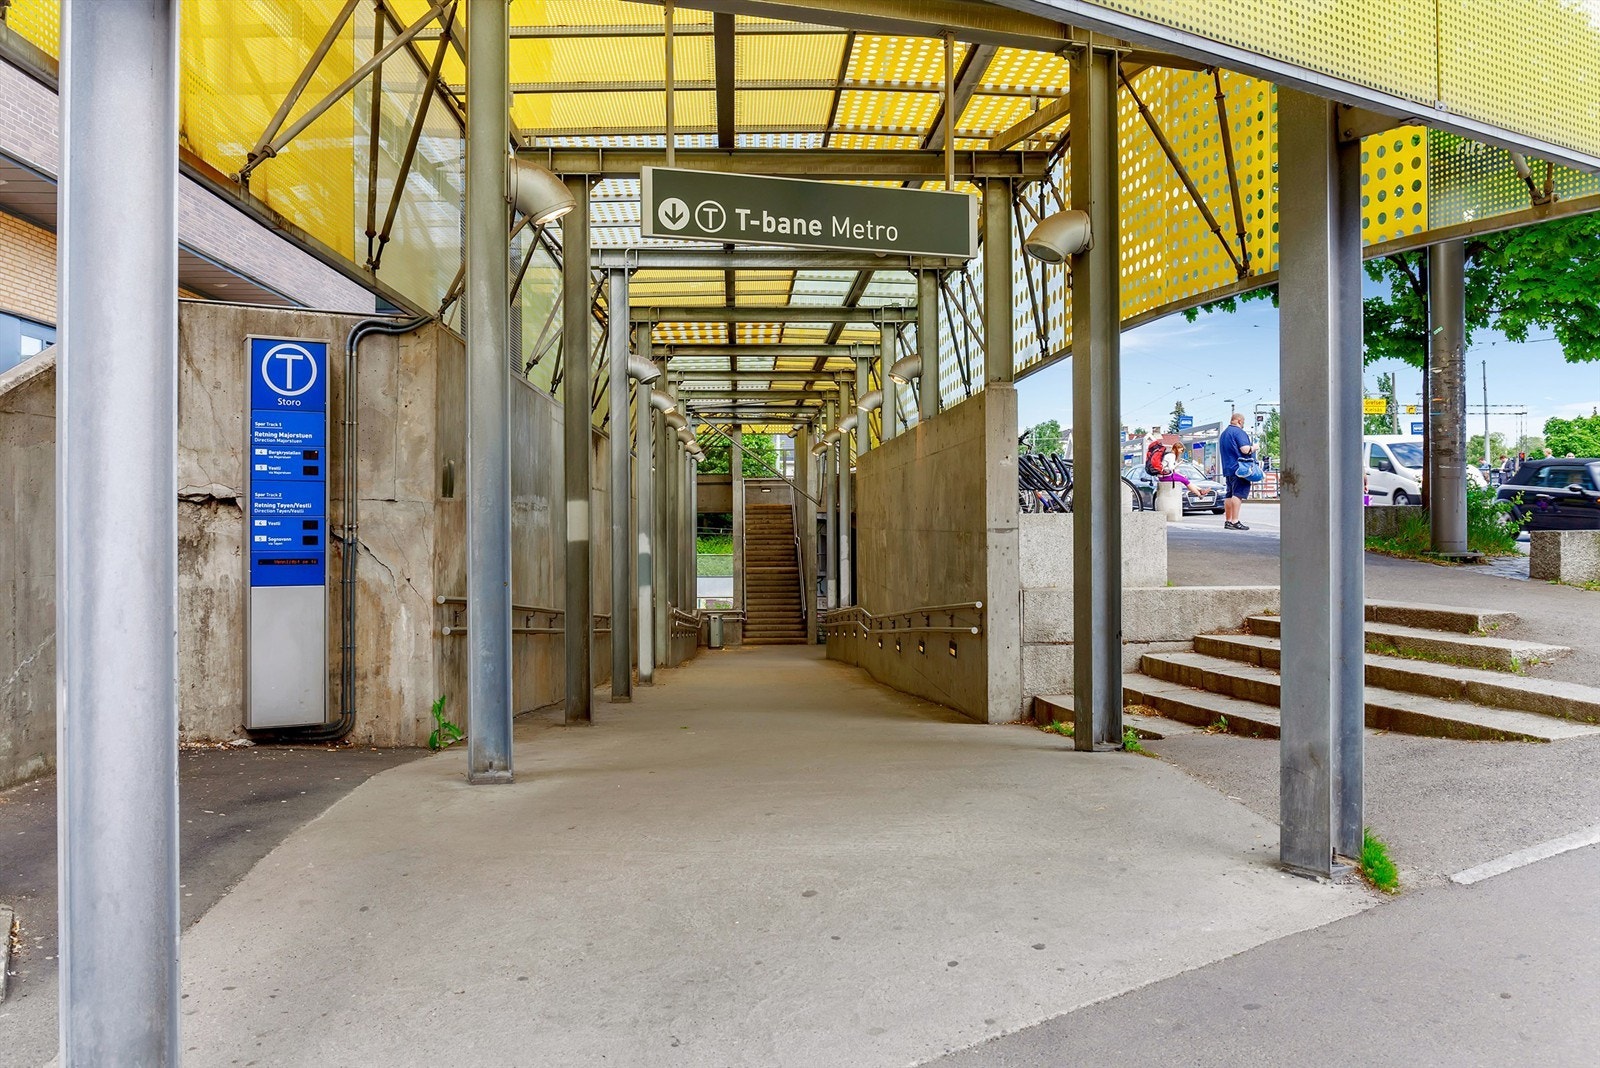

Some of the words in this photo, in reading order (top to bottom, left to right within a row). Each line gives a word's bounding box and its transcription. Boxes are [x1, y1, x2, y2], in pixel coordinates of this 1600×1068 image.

[735, 208, 822, 236] T-bane
[832, 215, 898, 242] Metro
[278, 398, 302, 406] Storo
